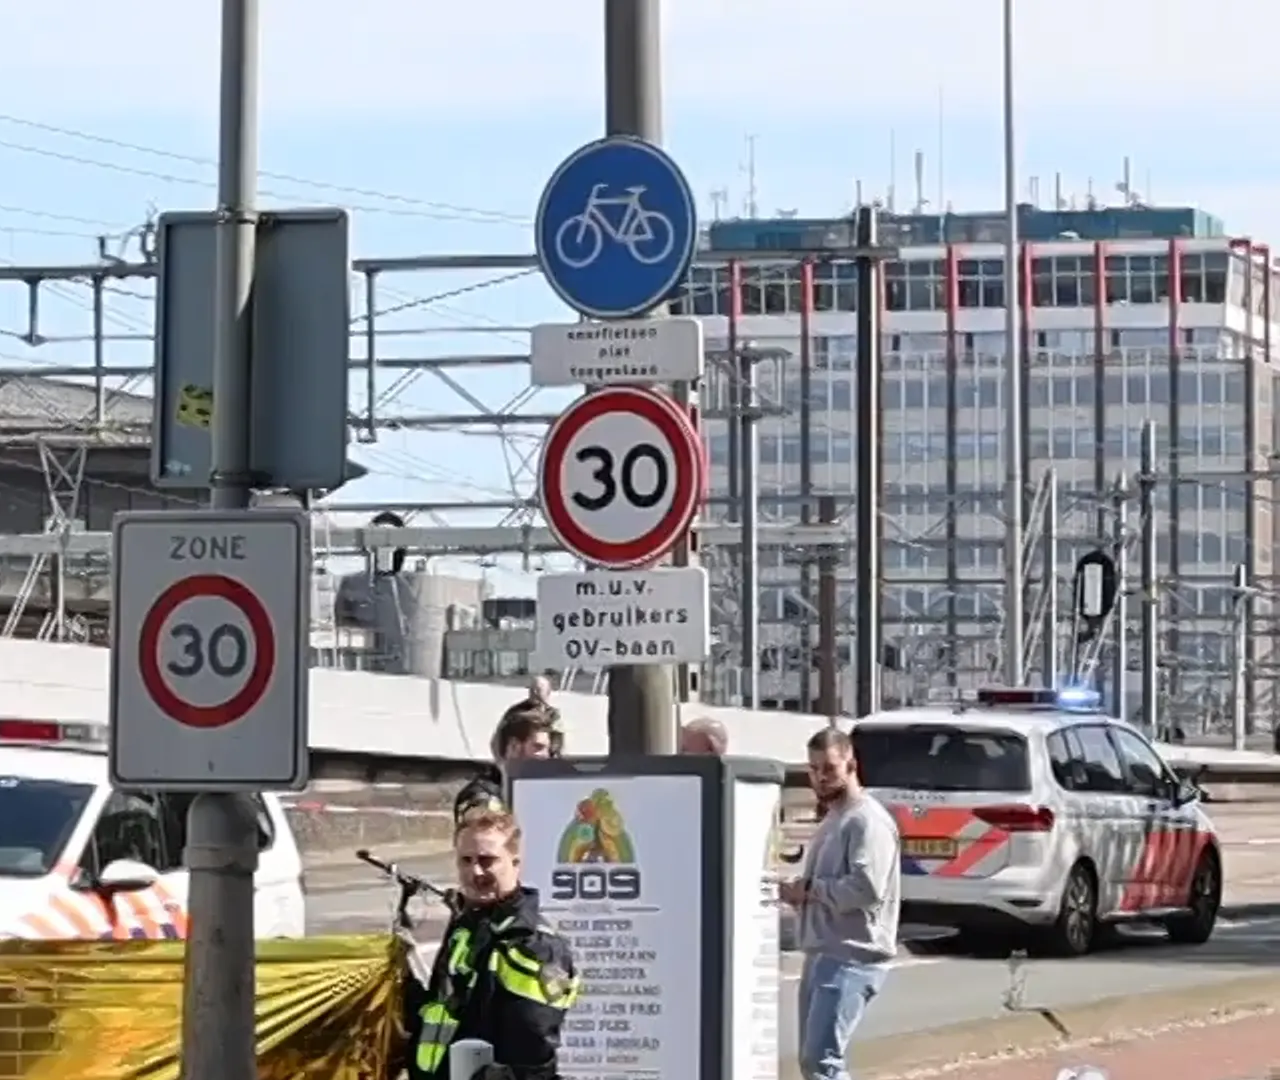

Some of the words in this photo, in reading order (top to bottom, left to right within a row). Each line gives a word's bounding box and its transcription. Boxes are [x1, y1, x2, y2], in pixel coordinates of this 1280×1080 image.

[571, 443, 669, 511] 30
[169, 535, 247, 560] ZONE
[575, 579, 654, 596] m.u.v.
[552, 604, 689, 634] gebruikers
[166, 623, 248, 678] 30
[565, 639, 676, 659] OV-baan
[551, 866, 641, 900] 909
